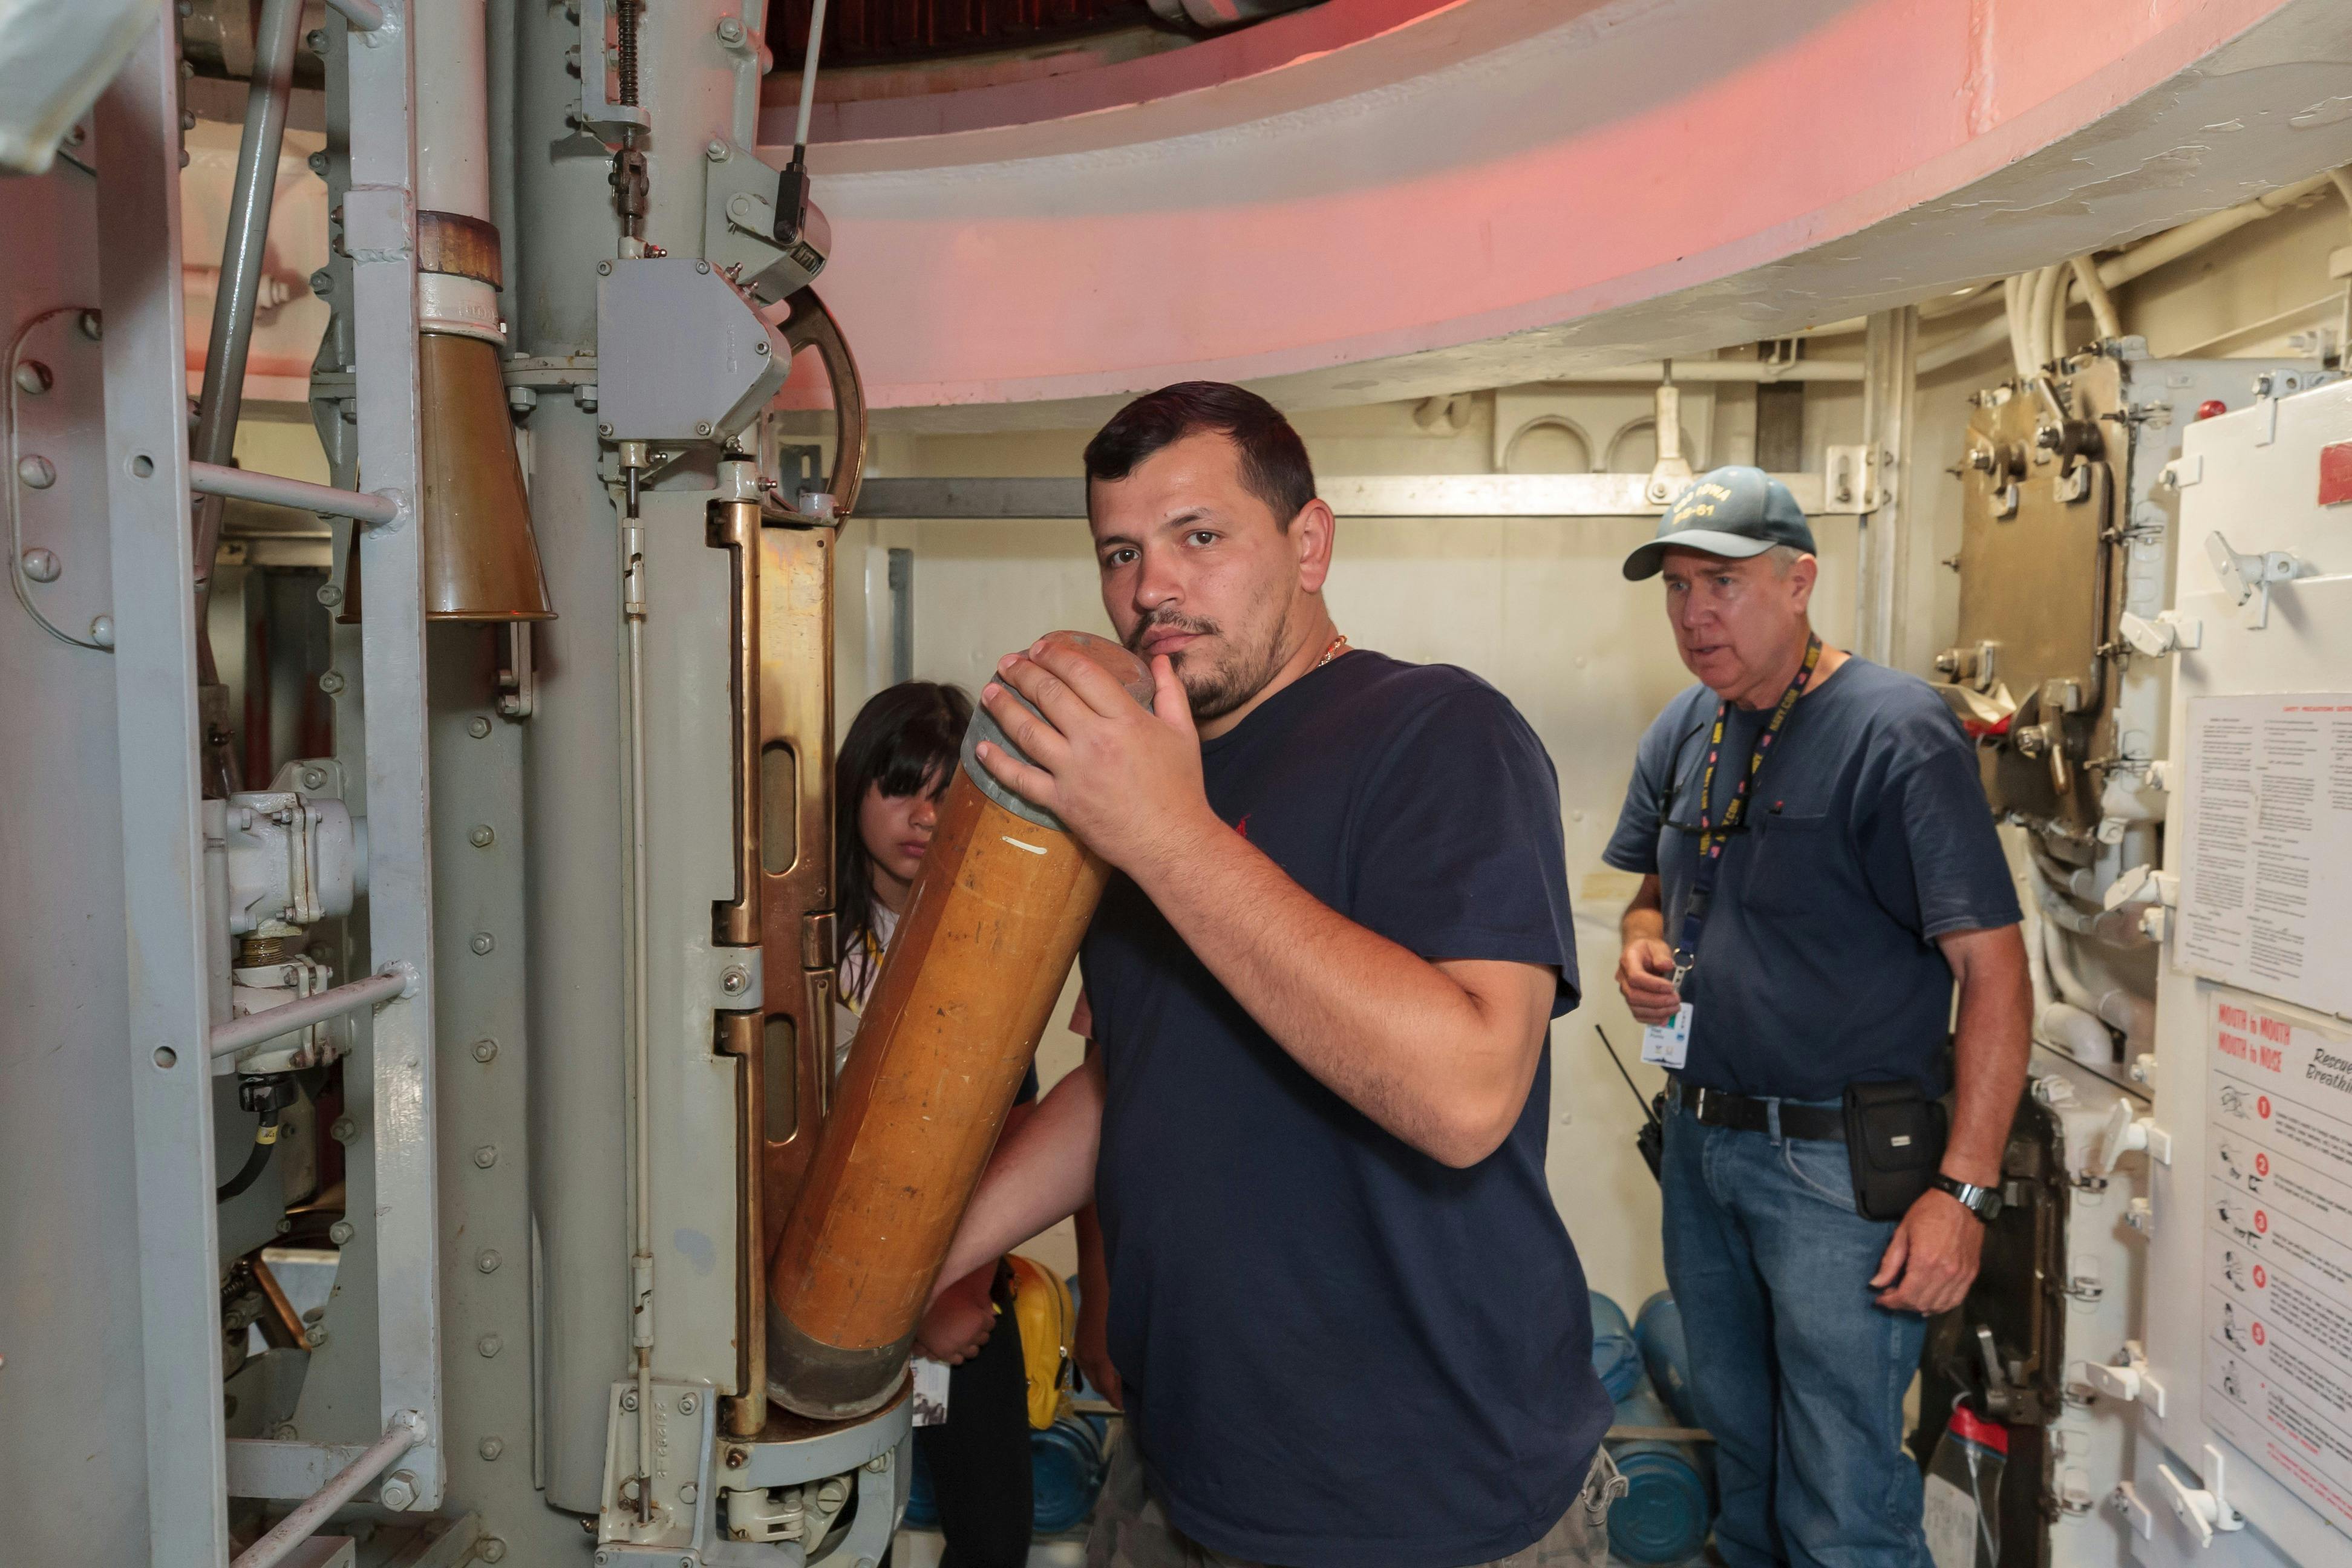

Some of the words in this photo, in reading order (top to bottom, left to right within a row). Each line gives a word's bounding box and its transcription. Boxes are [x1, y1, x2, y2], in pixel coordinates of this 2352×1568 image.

[1696, 483, 1731, 501] IOWA
[2219, 1004, 2247, 1031] MOUTH
[2250, 1015, 2256, 1034] to
[2260, 1016, 2290, 1045] MOUTH
[2219, 1031, 2246, 1060] MOUTH
[2250, 1045, 2256, 1064] to
[2260, 1045, 2282, 1073] NOSE
[2313, 1048, 2352, 1075] Rescue
